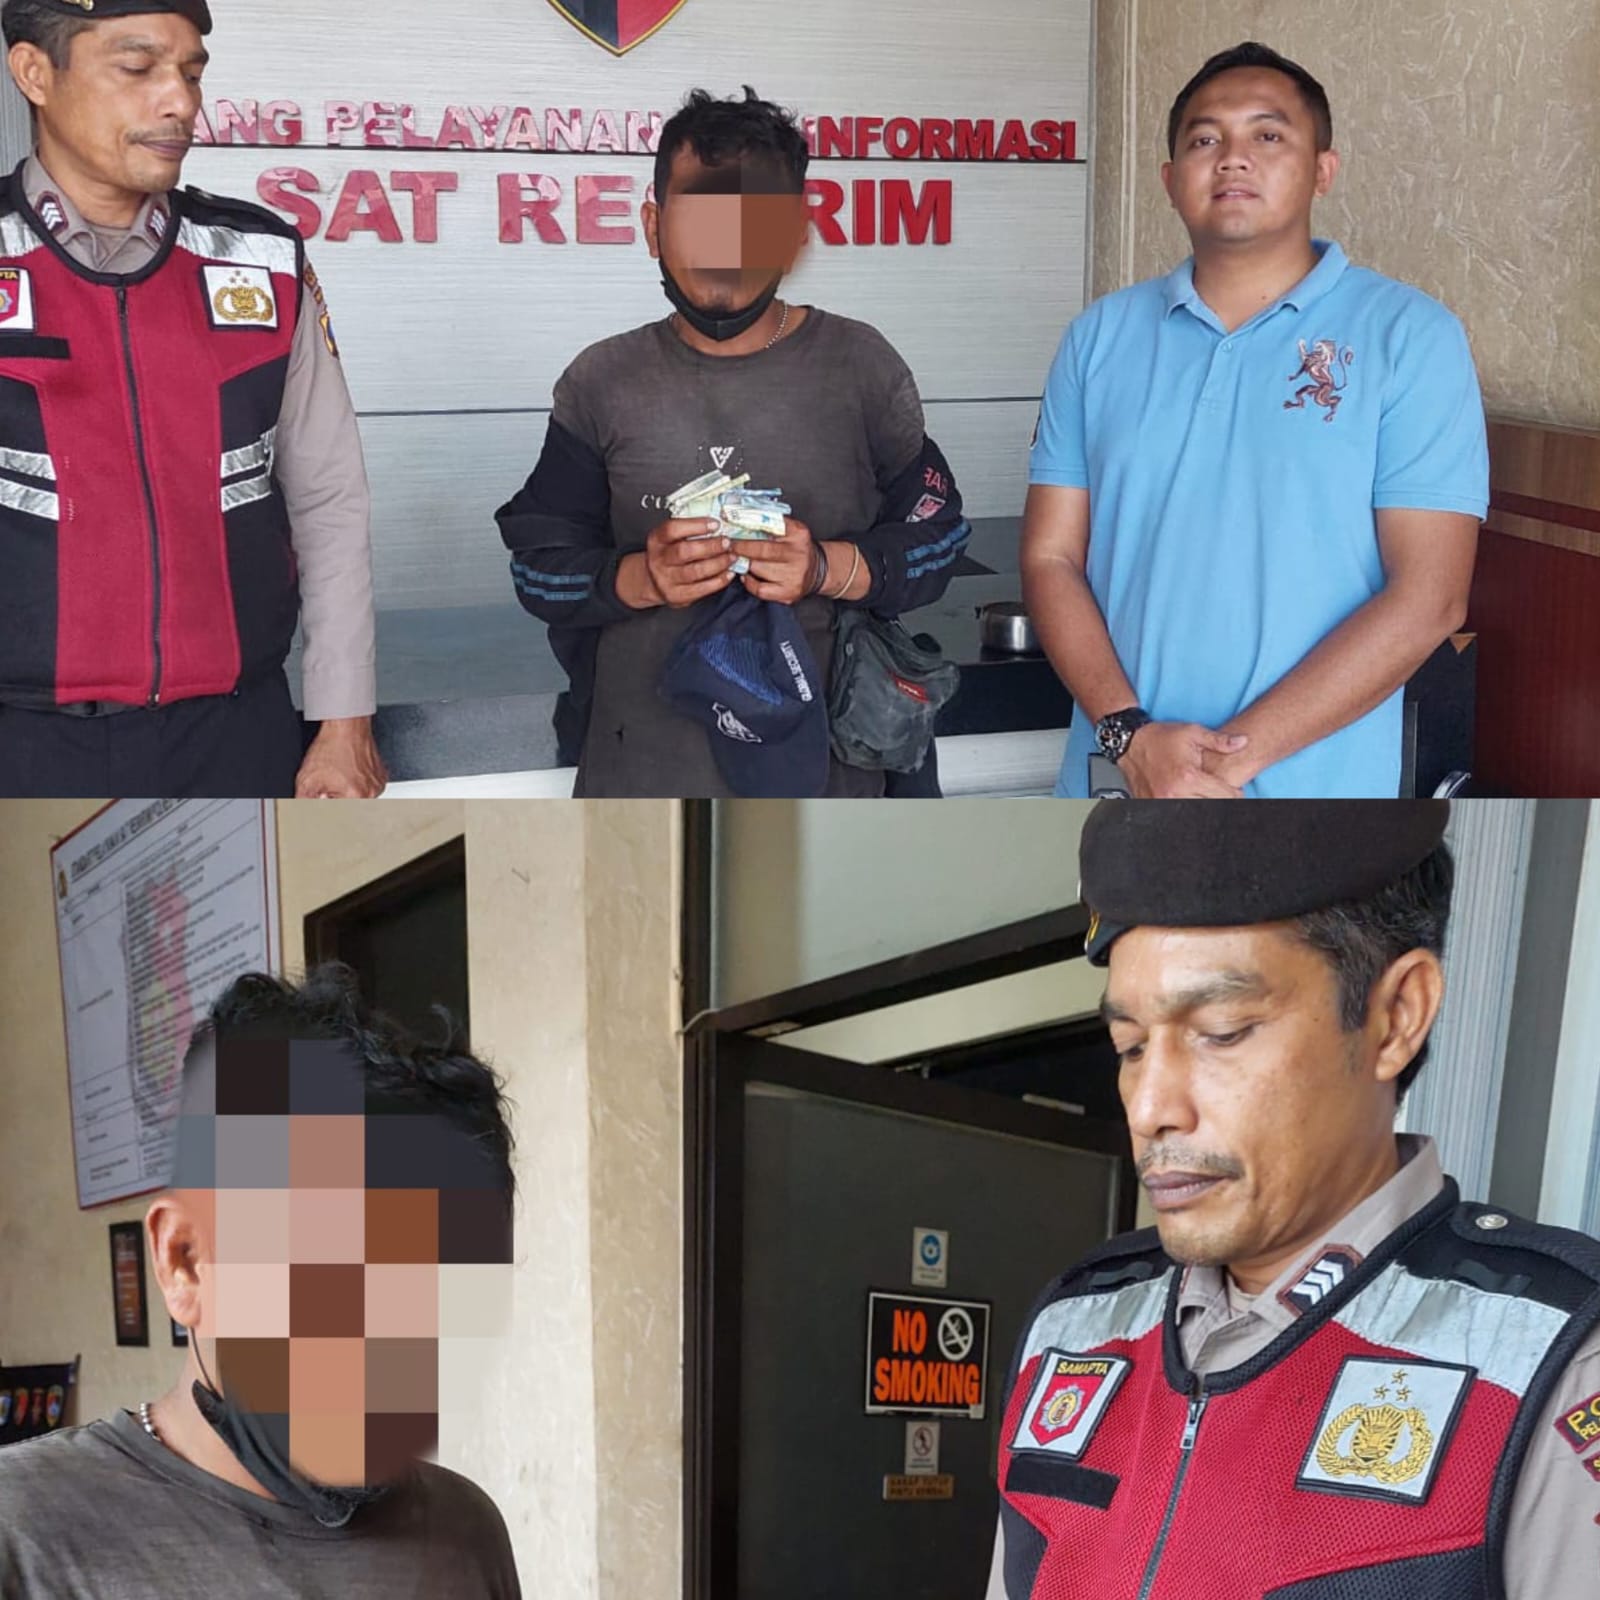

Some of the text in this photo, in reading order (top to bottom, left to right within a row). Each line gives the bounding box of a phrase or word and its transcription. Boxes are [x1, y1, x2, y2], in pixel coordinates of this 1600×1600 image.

[323, 99, 661, 154] PELAYANAN
[255, 166, 459, 244] SAT
[873, 1308, 980, 1405] NO SMOKING
